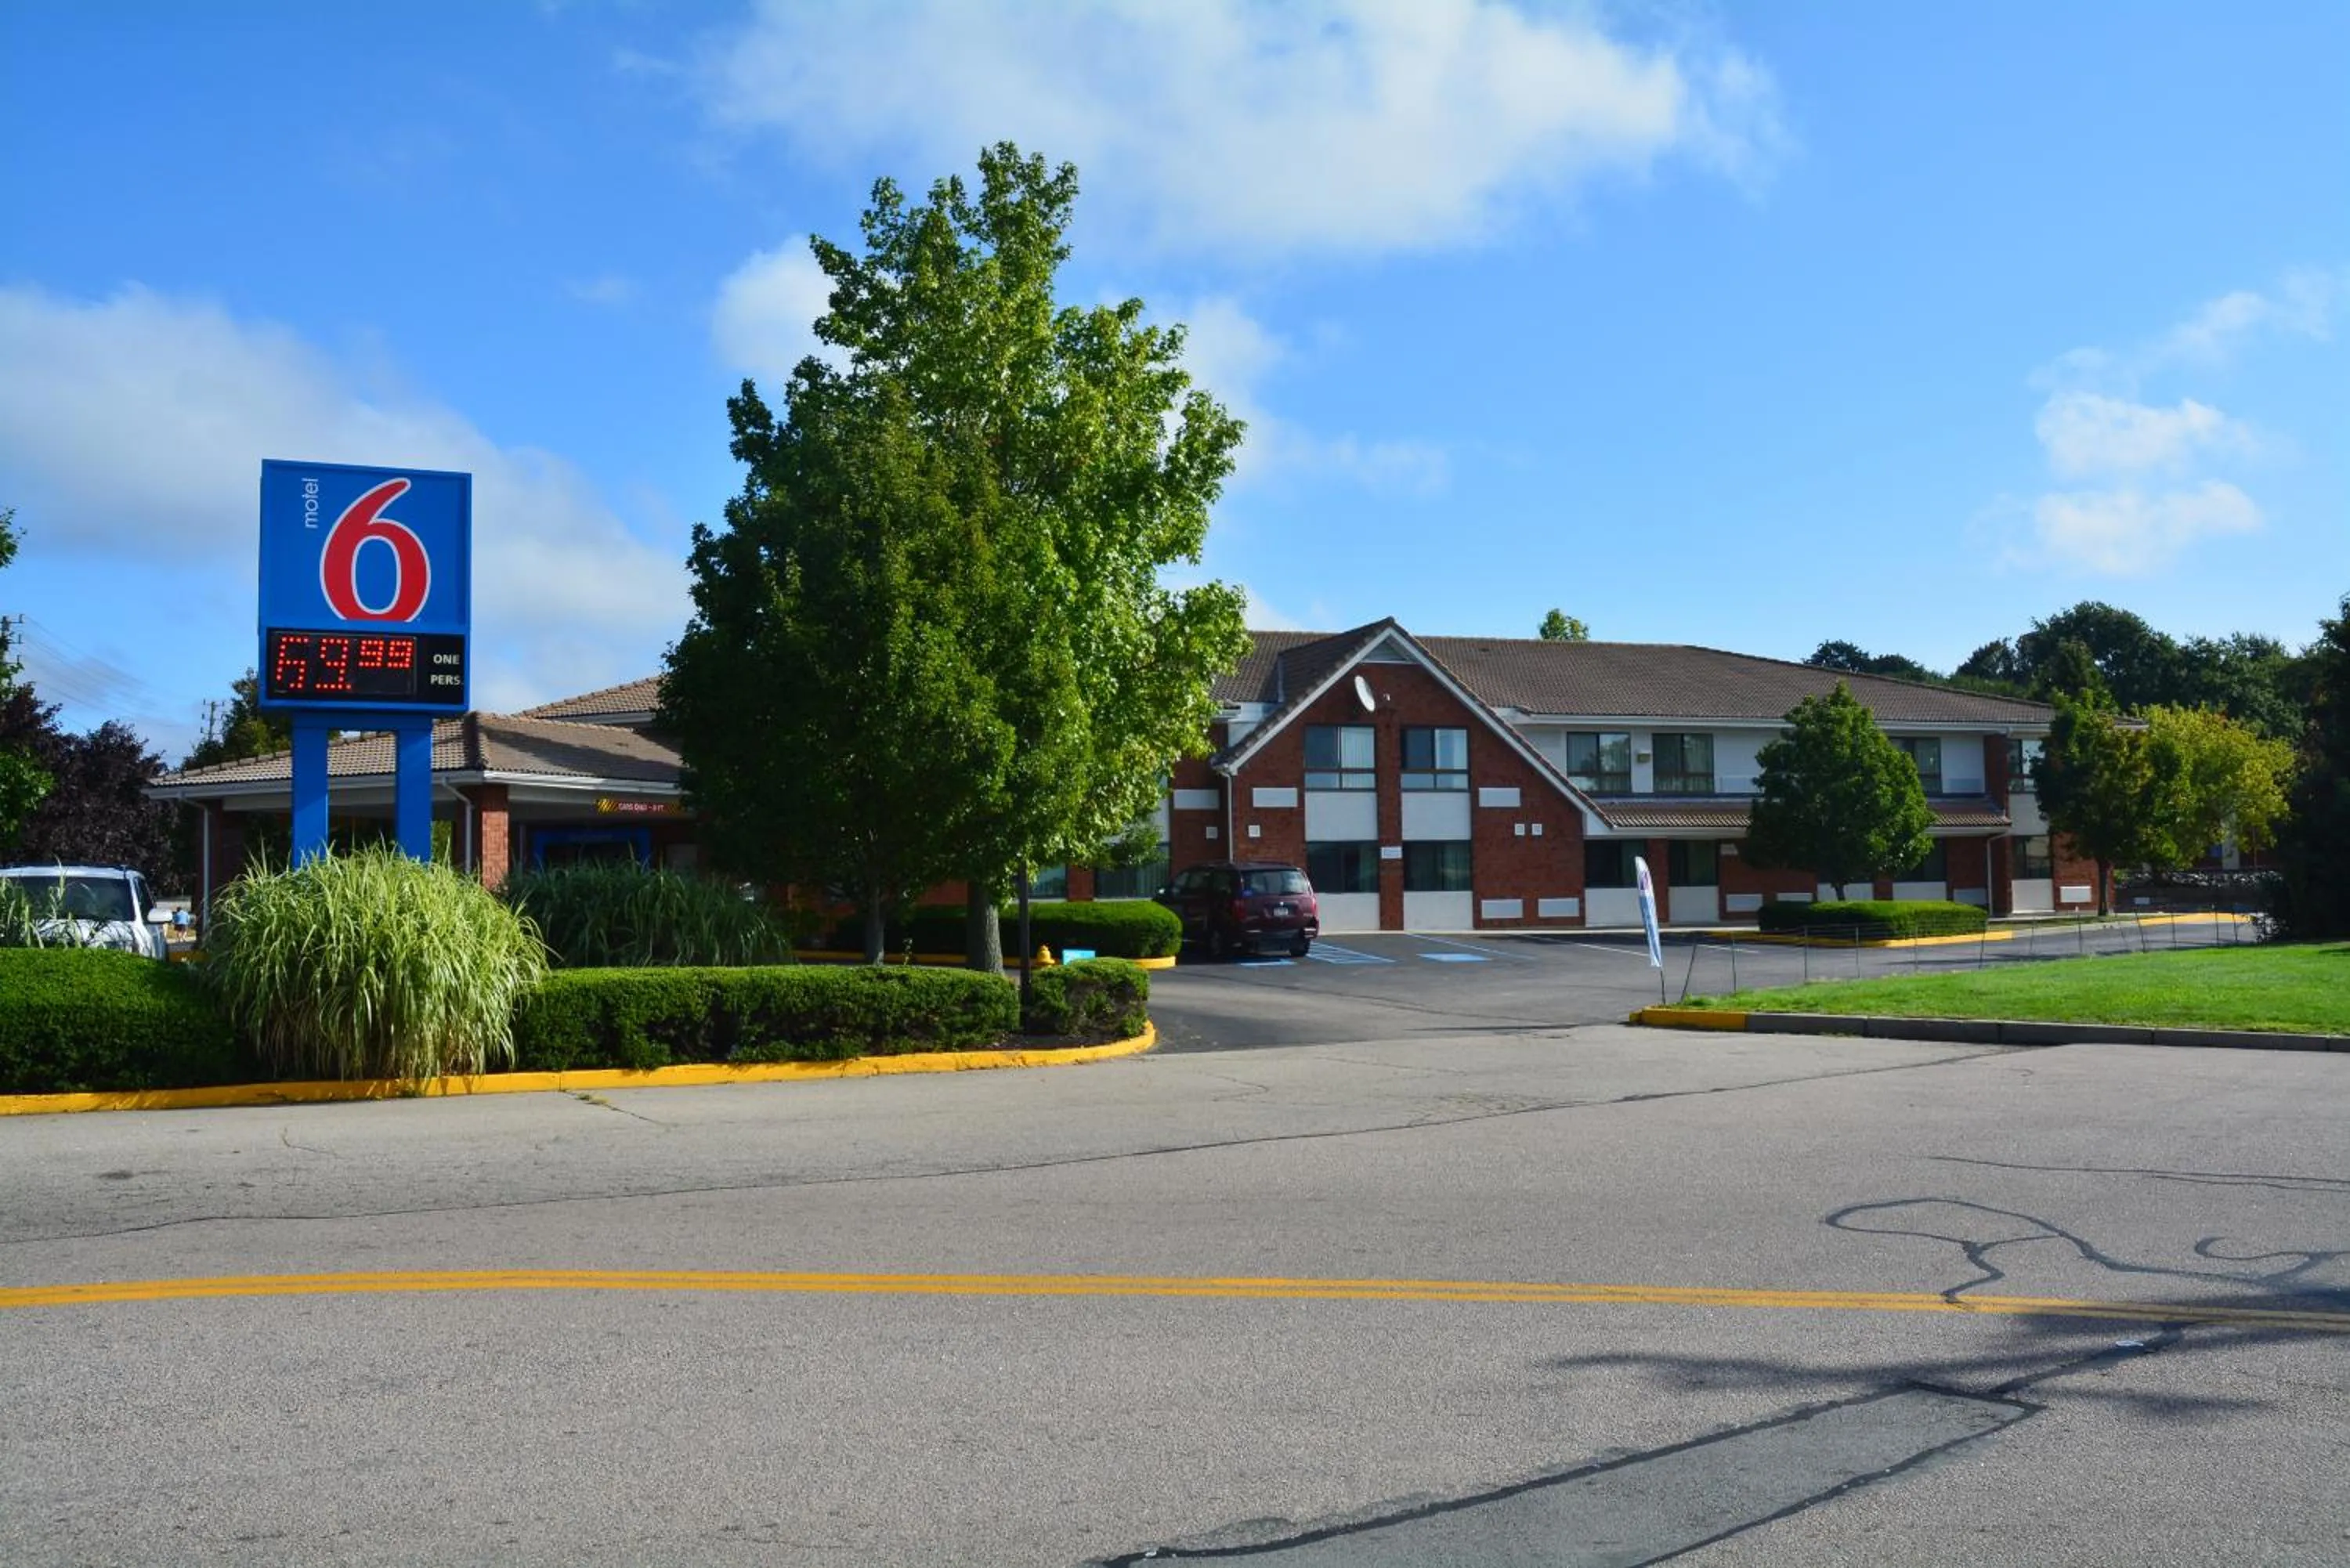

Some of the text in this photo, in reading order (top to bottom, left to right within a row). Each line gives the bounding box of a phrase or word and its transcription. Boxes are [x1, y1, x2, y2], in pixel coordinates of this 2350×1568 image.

[301, 477, 431, 623] motel 6
[433, 654, 460, 665] ONE
